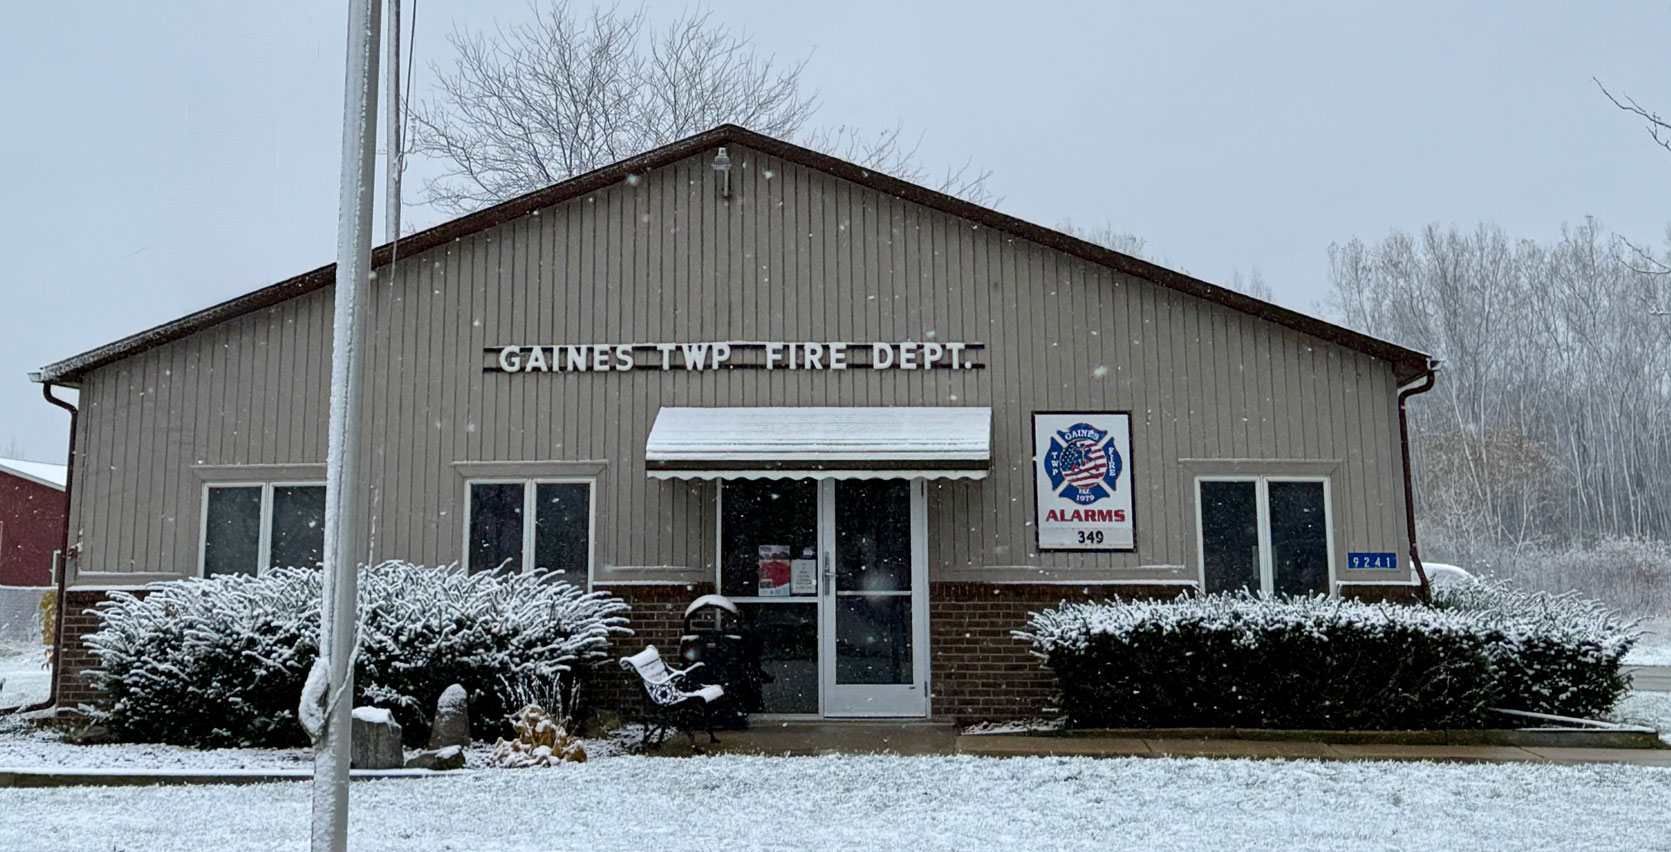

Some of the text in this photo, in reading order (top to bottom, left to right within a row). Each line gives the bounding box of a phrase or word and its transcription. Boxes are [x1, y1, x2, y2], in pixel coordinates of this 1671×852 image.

[499, 341, 972, 373] GAINES TWP FIRE DEPT.
[1064, 429, 1100, 441] GAINES
[1051, 452, 1060, 476] TWP
[1108, 447, 1117, 477] FIRE
[1076, 494, 1095, 502] 1979
[1046, 509, 1125, 522] ALARMS
[1077, 530, 1104, 544] 349
[1353, 557, 1390, 568] 9241
